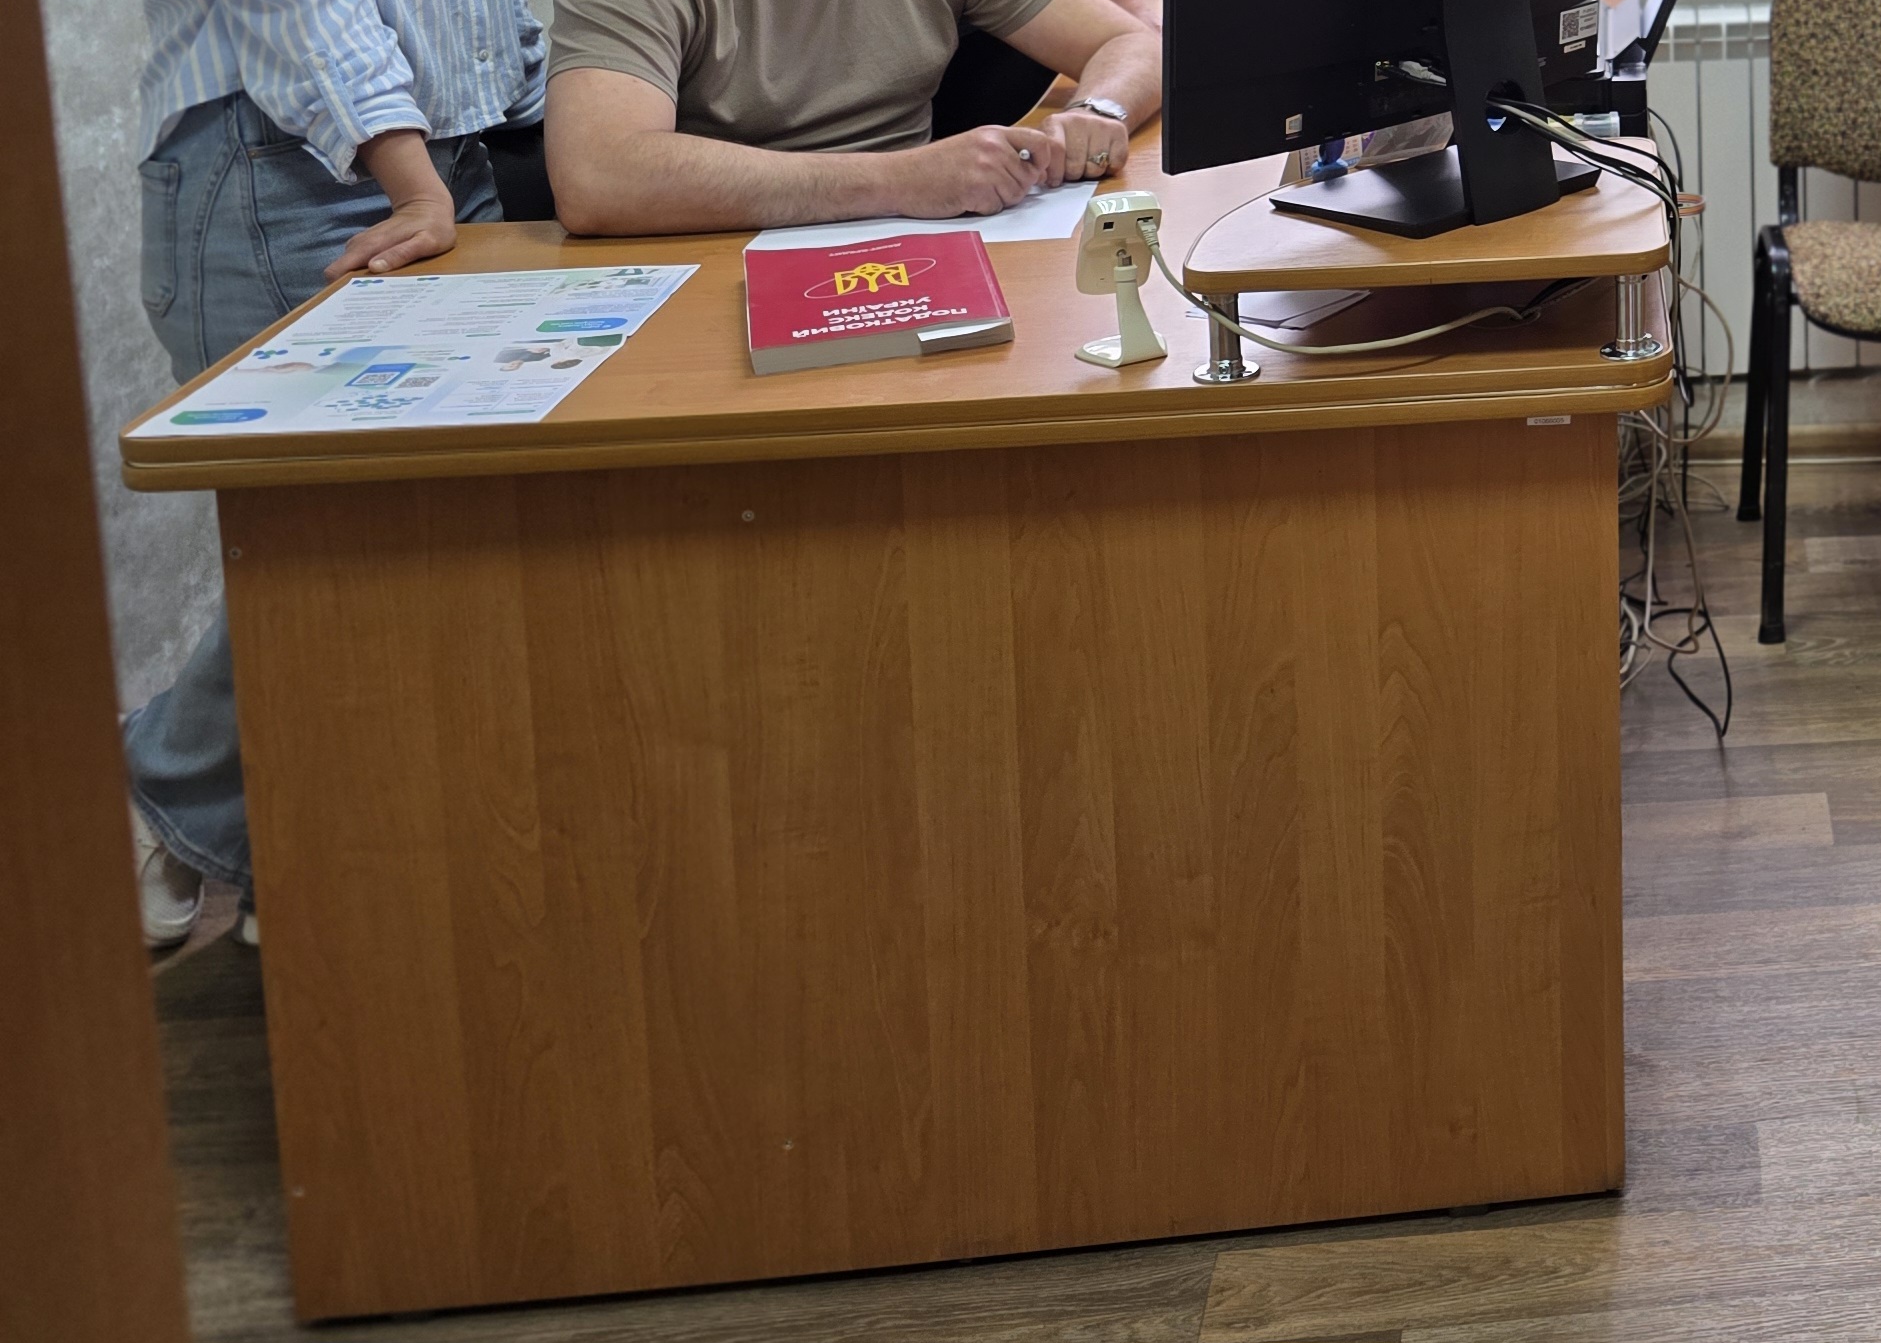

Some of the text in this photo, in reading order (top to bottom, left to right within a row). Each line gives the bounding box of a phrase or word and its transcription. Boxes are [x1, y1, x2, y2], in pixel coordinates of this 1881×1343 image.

[822, 296, 932, 317] УКРАЇНИ
[828, 304, 928, 325] КОДЕКС
[792, 308, 968, 338] ПОДАТКОВИЙ
